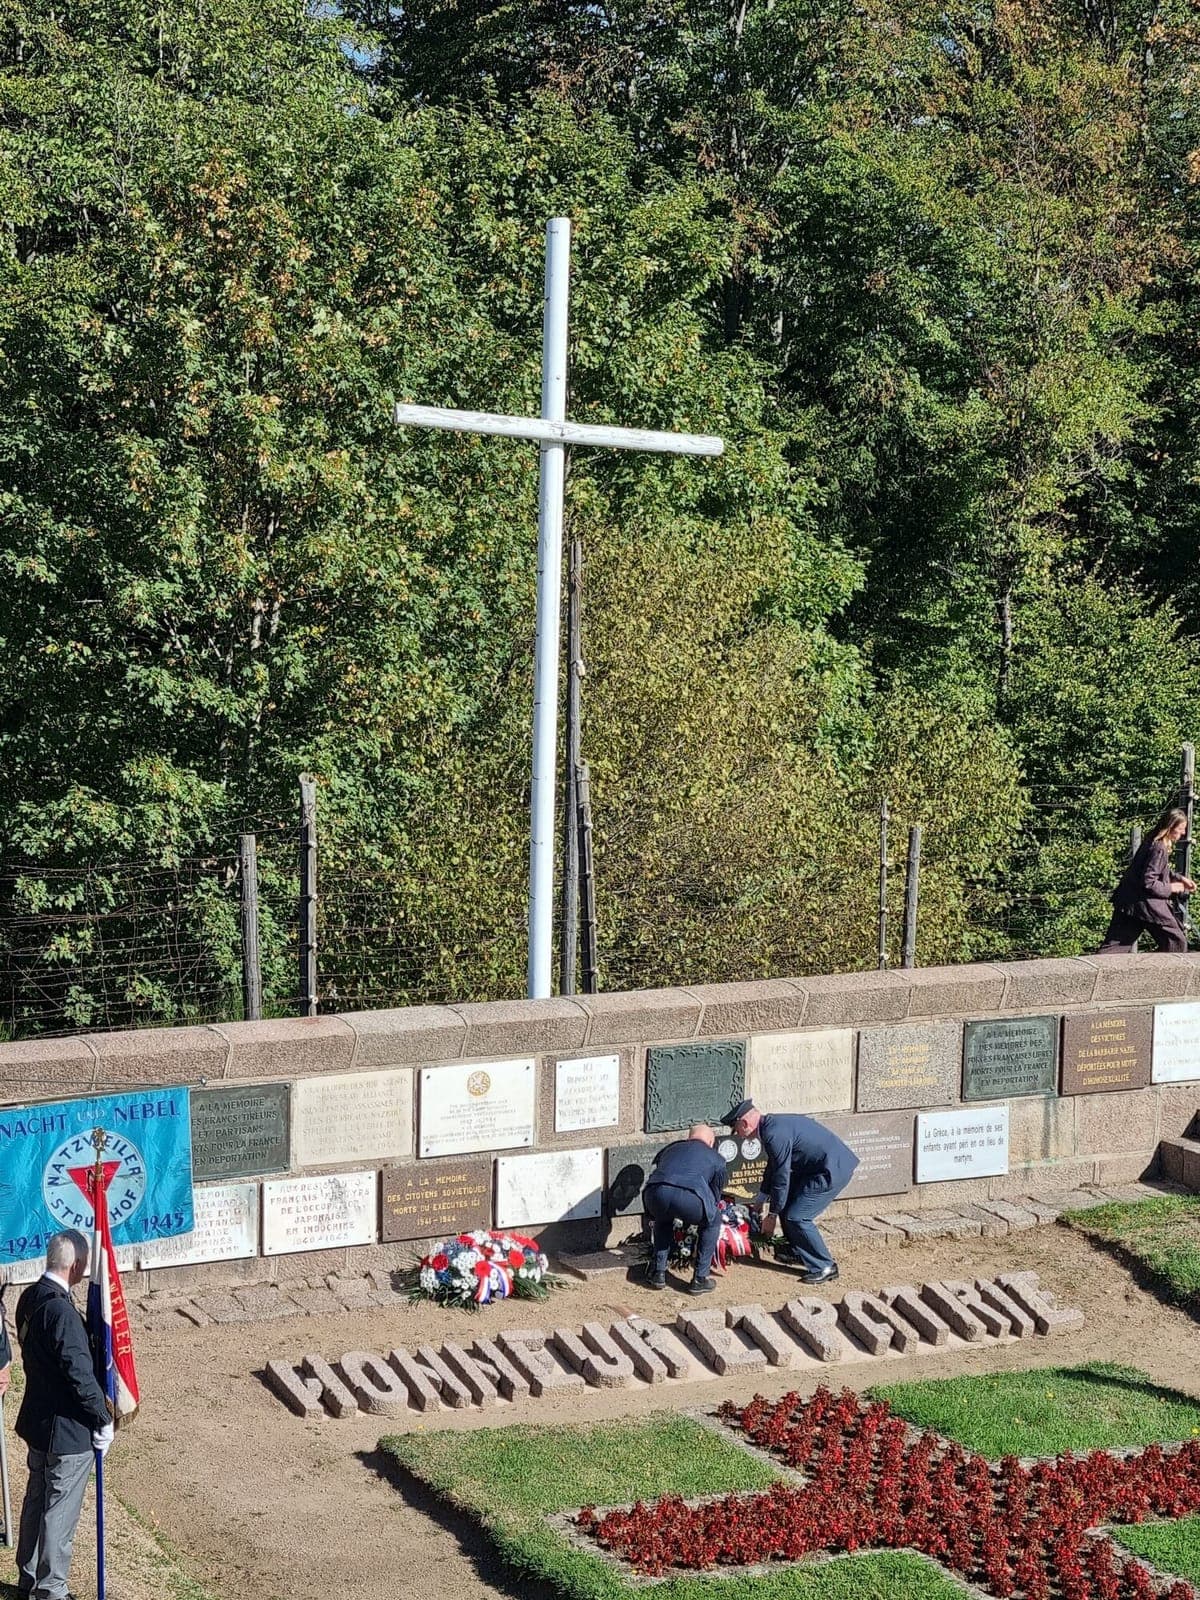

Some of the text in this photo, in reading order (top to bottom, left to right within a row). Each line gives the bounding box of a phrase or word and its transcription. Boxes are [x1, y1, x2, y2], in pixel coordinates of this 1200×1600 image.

[1030, 1038, 1044, 1048] DES
[1078, 1050, 1086, 1058] DE
[970, 1067, 993, 1076] MORTS
[1014, 1064, 1022, 1072] LA
[1023, 1061, 1049, 1071] FRANCE
[199, 1098, 266, 1112] A LA MEMOIRE
[0, 1100, 180, 1140] NACHT UND NEBEL
[192, 1118, 203, 1126] ES
[198, 1124, 265, 1140] ET PARTISANS
[924, 1128, 932, 1139] La
[986, 1122, 993, 1133] de
[995, 1124, 1004, 1132] ses
[192, 1142, 209, 1154] RTS
[236, 1140, 246, 1149] LA
[248, 1136, 281, 1148] FRANCE
[924, 1142, 942, 1152] enfants
[970, 1140, 978, 1148] en
[978, 1140, 985, 1148] ce
[987, 1137, 996, 1146] lieu
[194, 1150, 268, 1168] EN DEPORTATION
[747, 1162, 755, 1170] LA
[420, 1178, 430, 1186] LA
[748, 1176, 758, 1184] EN
[387, 1194, 401, 1202] DES
[405, 1190, 438, 1201] CITOYENS
[50, 1188, 137, 1228] STRUHOF
[393, 1206, 417, 1216] MORTS
[432, 1200, 468, 1211] EXECUTES
[140, 1212, 185, 1234] 1945
[263, 1270, 1085, 1420] HONNEUR ET PATRIE
